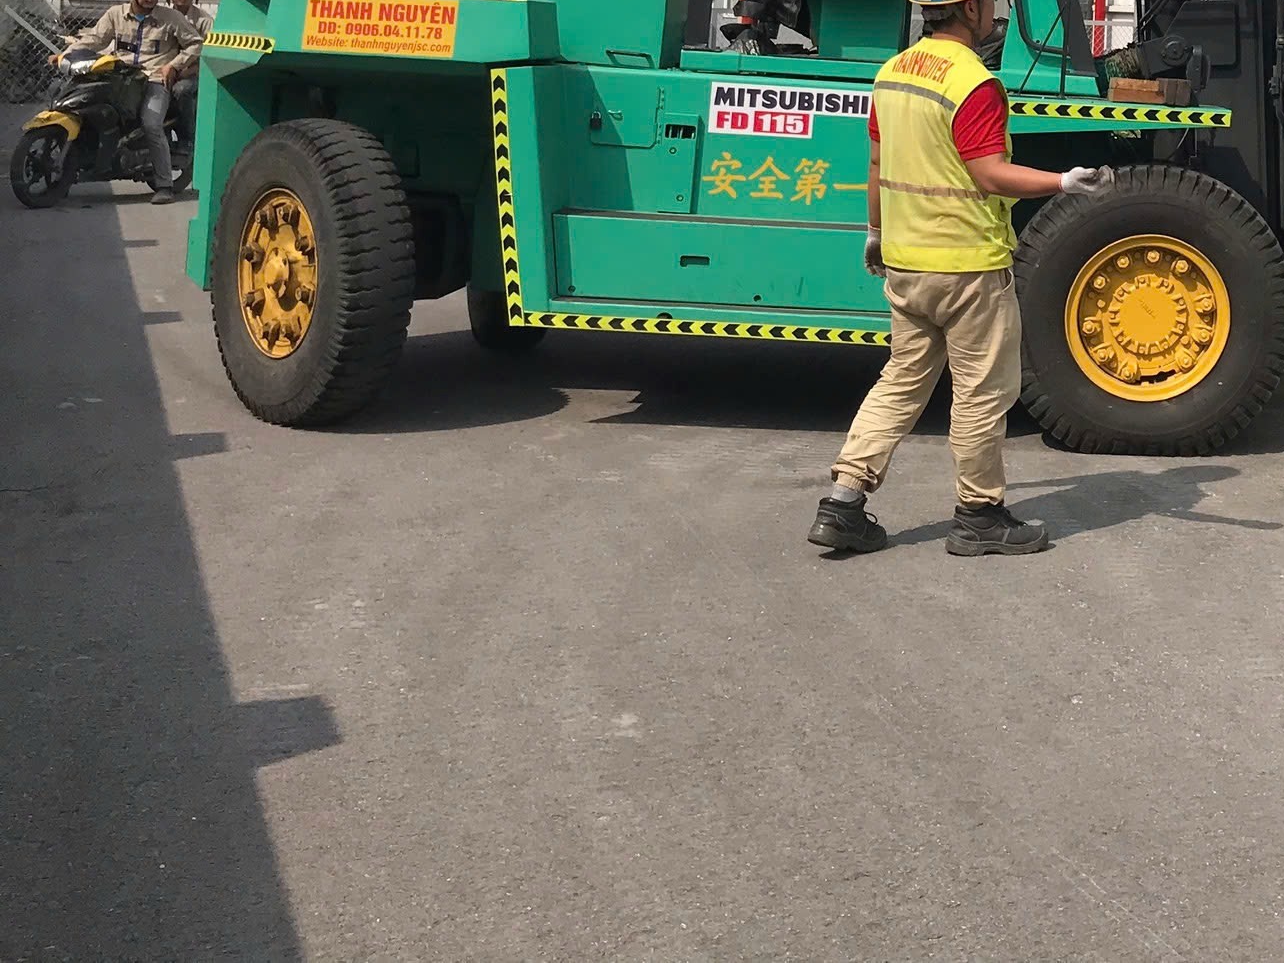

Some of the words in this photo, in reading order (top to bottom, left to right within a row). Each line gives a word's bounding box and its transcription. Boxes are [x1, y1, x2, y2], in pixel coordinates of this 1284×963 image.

[378, 2, 455, 25] NGUYÊN
[345, 23, 443, 40] 0906.04.11.78
[306, 35, 347, 48] Website:
[350, 38, 452, 54] thanhnguyenjsc.com
[714, 86, 869, 115] MITSUBISHI
[716, 111, 749, 129] FD
[758, 113, 804, 133] 115
[703, 152, 868, 205] 安全第一
